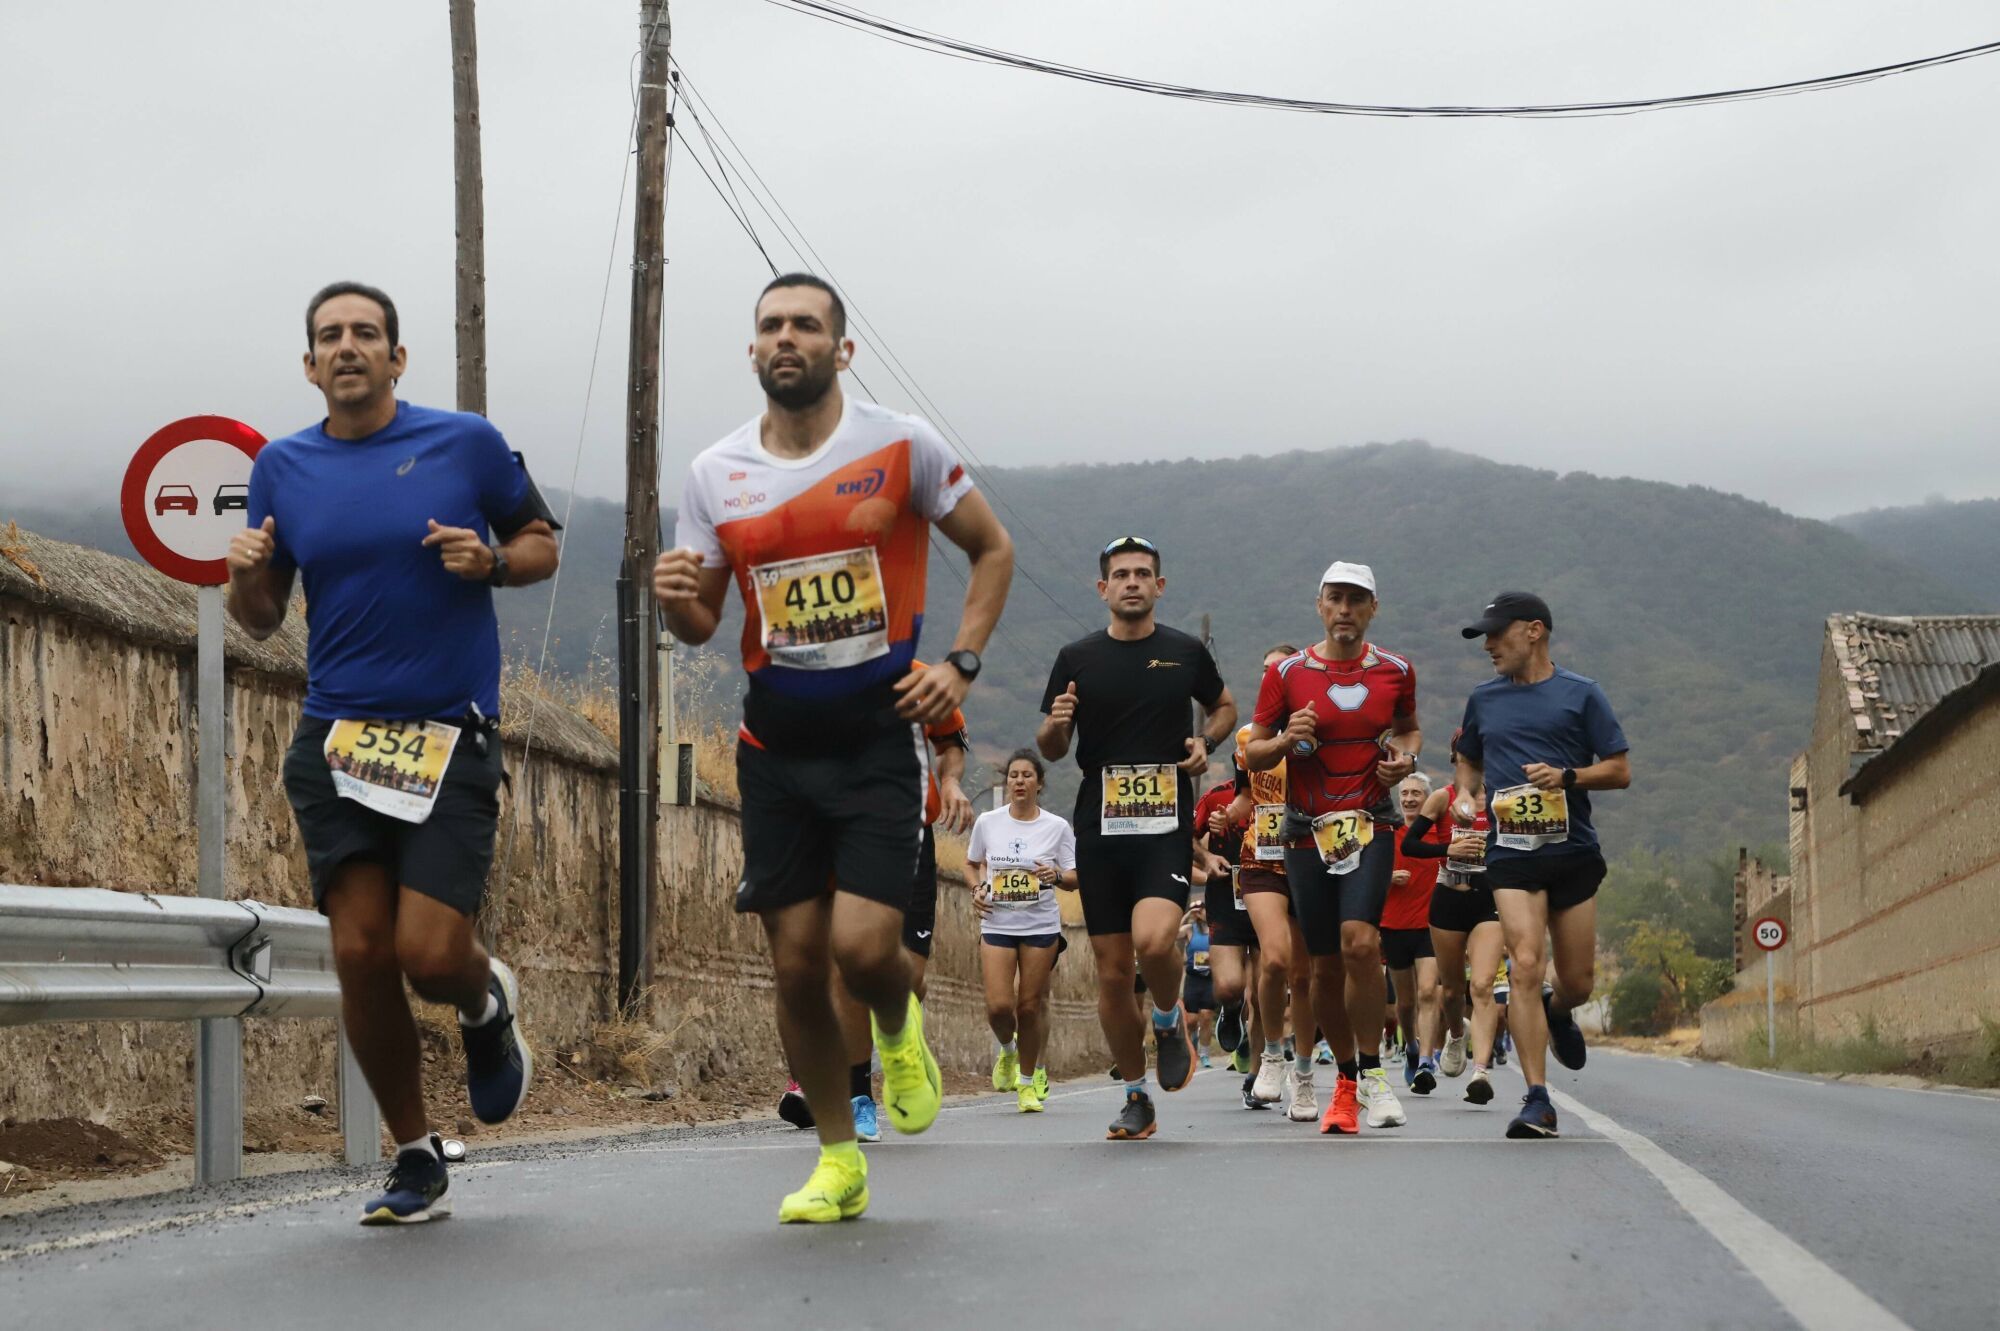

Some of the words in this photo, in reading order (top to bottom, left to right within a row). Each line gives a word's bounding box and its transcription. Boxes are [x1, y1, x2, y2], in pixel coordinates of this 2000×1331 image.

[835, 474, 878, 497] KH7
[784, 569, 856, 611] 410
[355, 723, 427, 762] 554
[1118, 776, 1161, 796] 361
[1515, 794, 1544, 815] 33
[1333, 817, 1357, 838] 27
[1002, 874, 1030, 888] 164
[1760, 928, 1779, 939] 50
